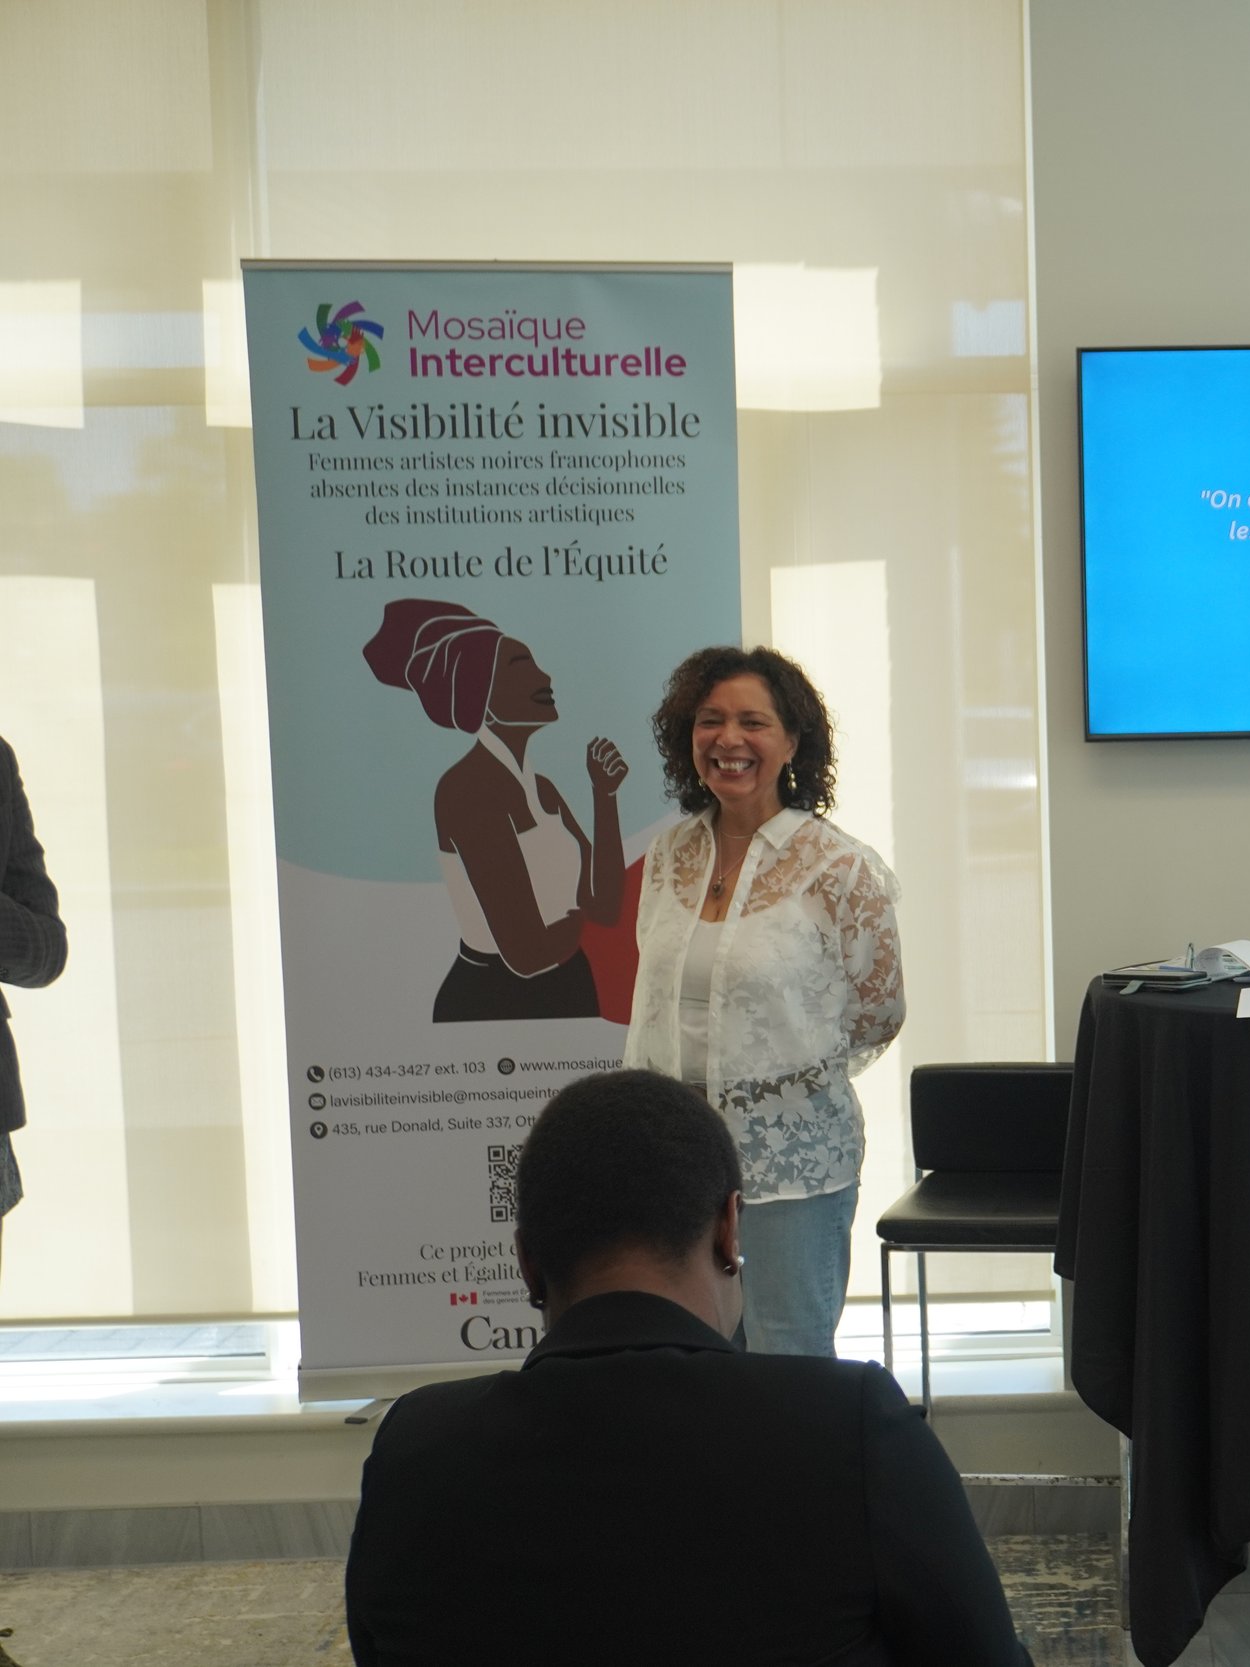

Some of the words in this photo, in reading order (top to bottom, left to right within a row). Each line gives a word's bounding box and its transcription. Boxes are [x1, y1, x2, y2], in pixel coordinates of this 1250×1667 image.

[408, 310, 585, 347] Mosaïque
[410, 347, 686, 377] Interculturelle
[291, 407, 336, 440] La
[348, 401, 523, 440] Visibilité
[537, 403, 699, 438] invisible
[309, 453, 393, 471] Femmes
[401, 451, 474, 470] artistes
[482, 451, 543, 469] noires
[551, 450, 685, 472] francophones
[311, 479, 398, 498] absentes
[406, 478, 439, 497] des
[446, 478, 539, 496] instances
[546, 476, 684, 496] décisionnelles
[1201, 490, 1241, 509] "On
[366, 506, 399, 524] des
[407, 505, 522, 524] institutions
[529, 504, 634, 526] artistiques
[336, 552, 373, 579] La
[387, 551, 482, 578] Route
[495, 547, 532, 576] de
[543, 540, 667, 582] l’Équité
[329, 1066, 361, 1081] (613)
[365, 1064, 430, 1078] 434-3427
[435, 1063, 459, 1075] ext.
[463, 1061, 485, 1073] 103
[520, 1058, 623, 1072] www.mosaique
[330, 1088, 560, 1108] lavisibiliteinvisible@mosaiqueinte
[332, 1123, 360, 1135] 435,
[365, 1124, 387, 1134] rue
[392, 1118, 443, 1133] Donald,
[448, 1118, 482, 1130] Suite
[486, 1116, 511, 1129] 337,
[516, 1115, 536, 1128] Ott
[420, 1245, 444, 1260] Ce
[451, 1241, 503, 1262] projet
[359, 1271, 436, 1287] Femmes
[442, 1268, 458, 1283] et
[461, 1315, 546, 1351] Can
